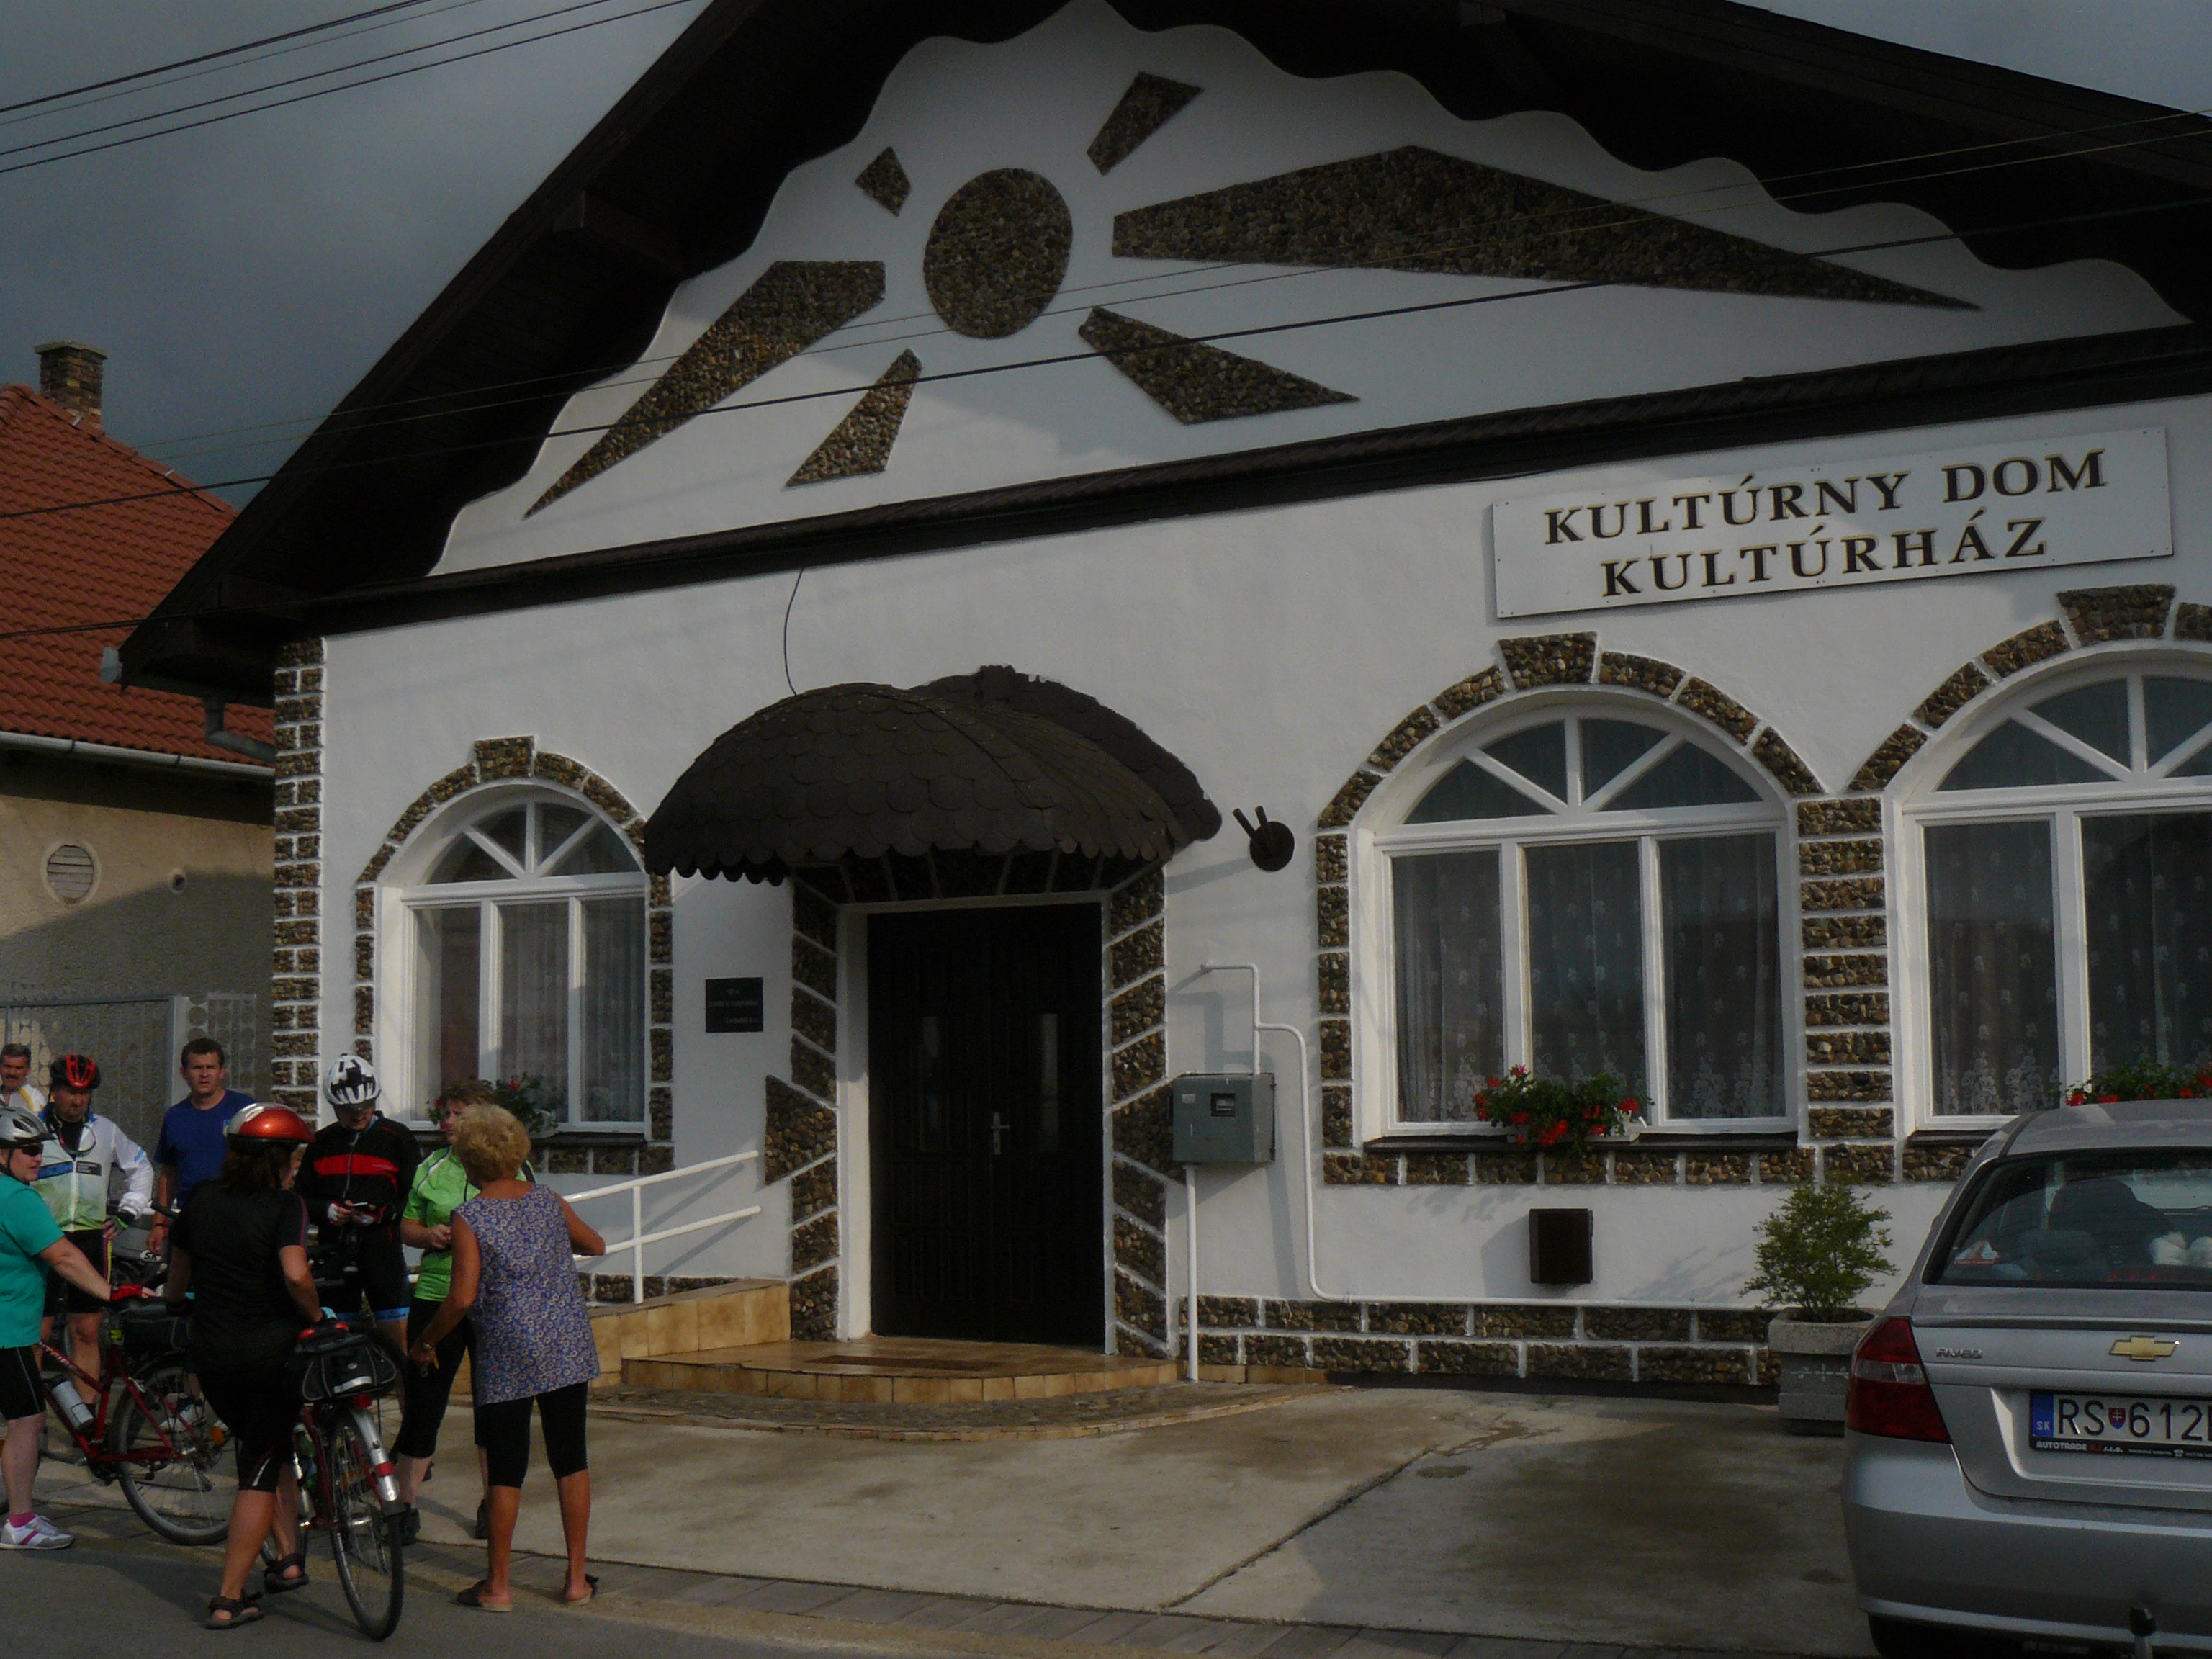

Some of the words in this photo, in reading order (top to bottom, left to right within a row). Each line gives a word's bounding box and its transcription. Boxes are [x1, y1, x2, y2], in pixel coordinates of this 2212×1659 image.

[1545, 471, 1910, 544] KULTÚRNY
[1941, 449, 2106, 503] DOM
[1601, 507, 2046, 597] KULTÚRHÁZ
[1936, 1347, 1982, 1359] AVEO
[2036, 1421, 2051, 1431] SK
[2058, 1398, 2105, 1436] RS
[2128, 1402, 2212, 1442] 612
[2036, 1441, 2087, 1451] AUTOTRADE
